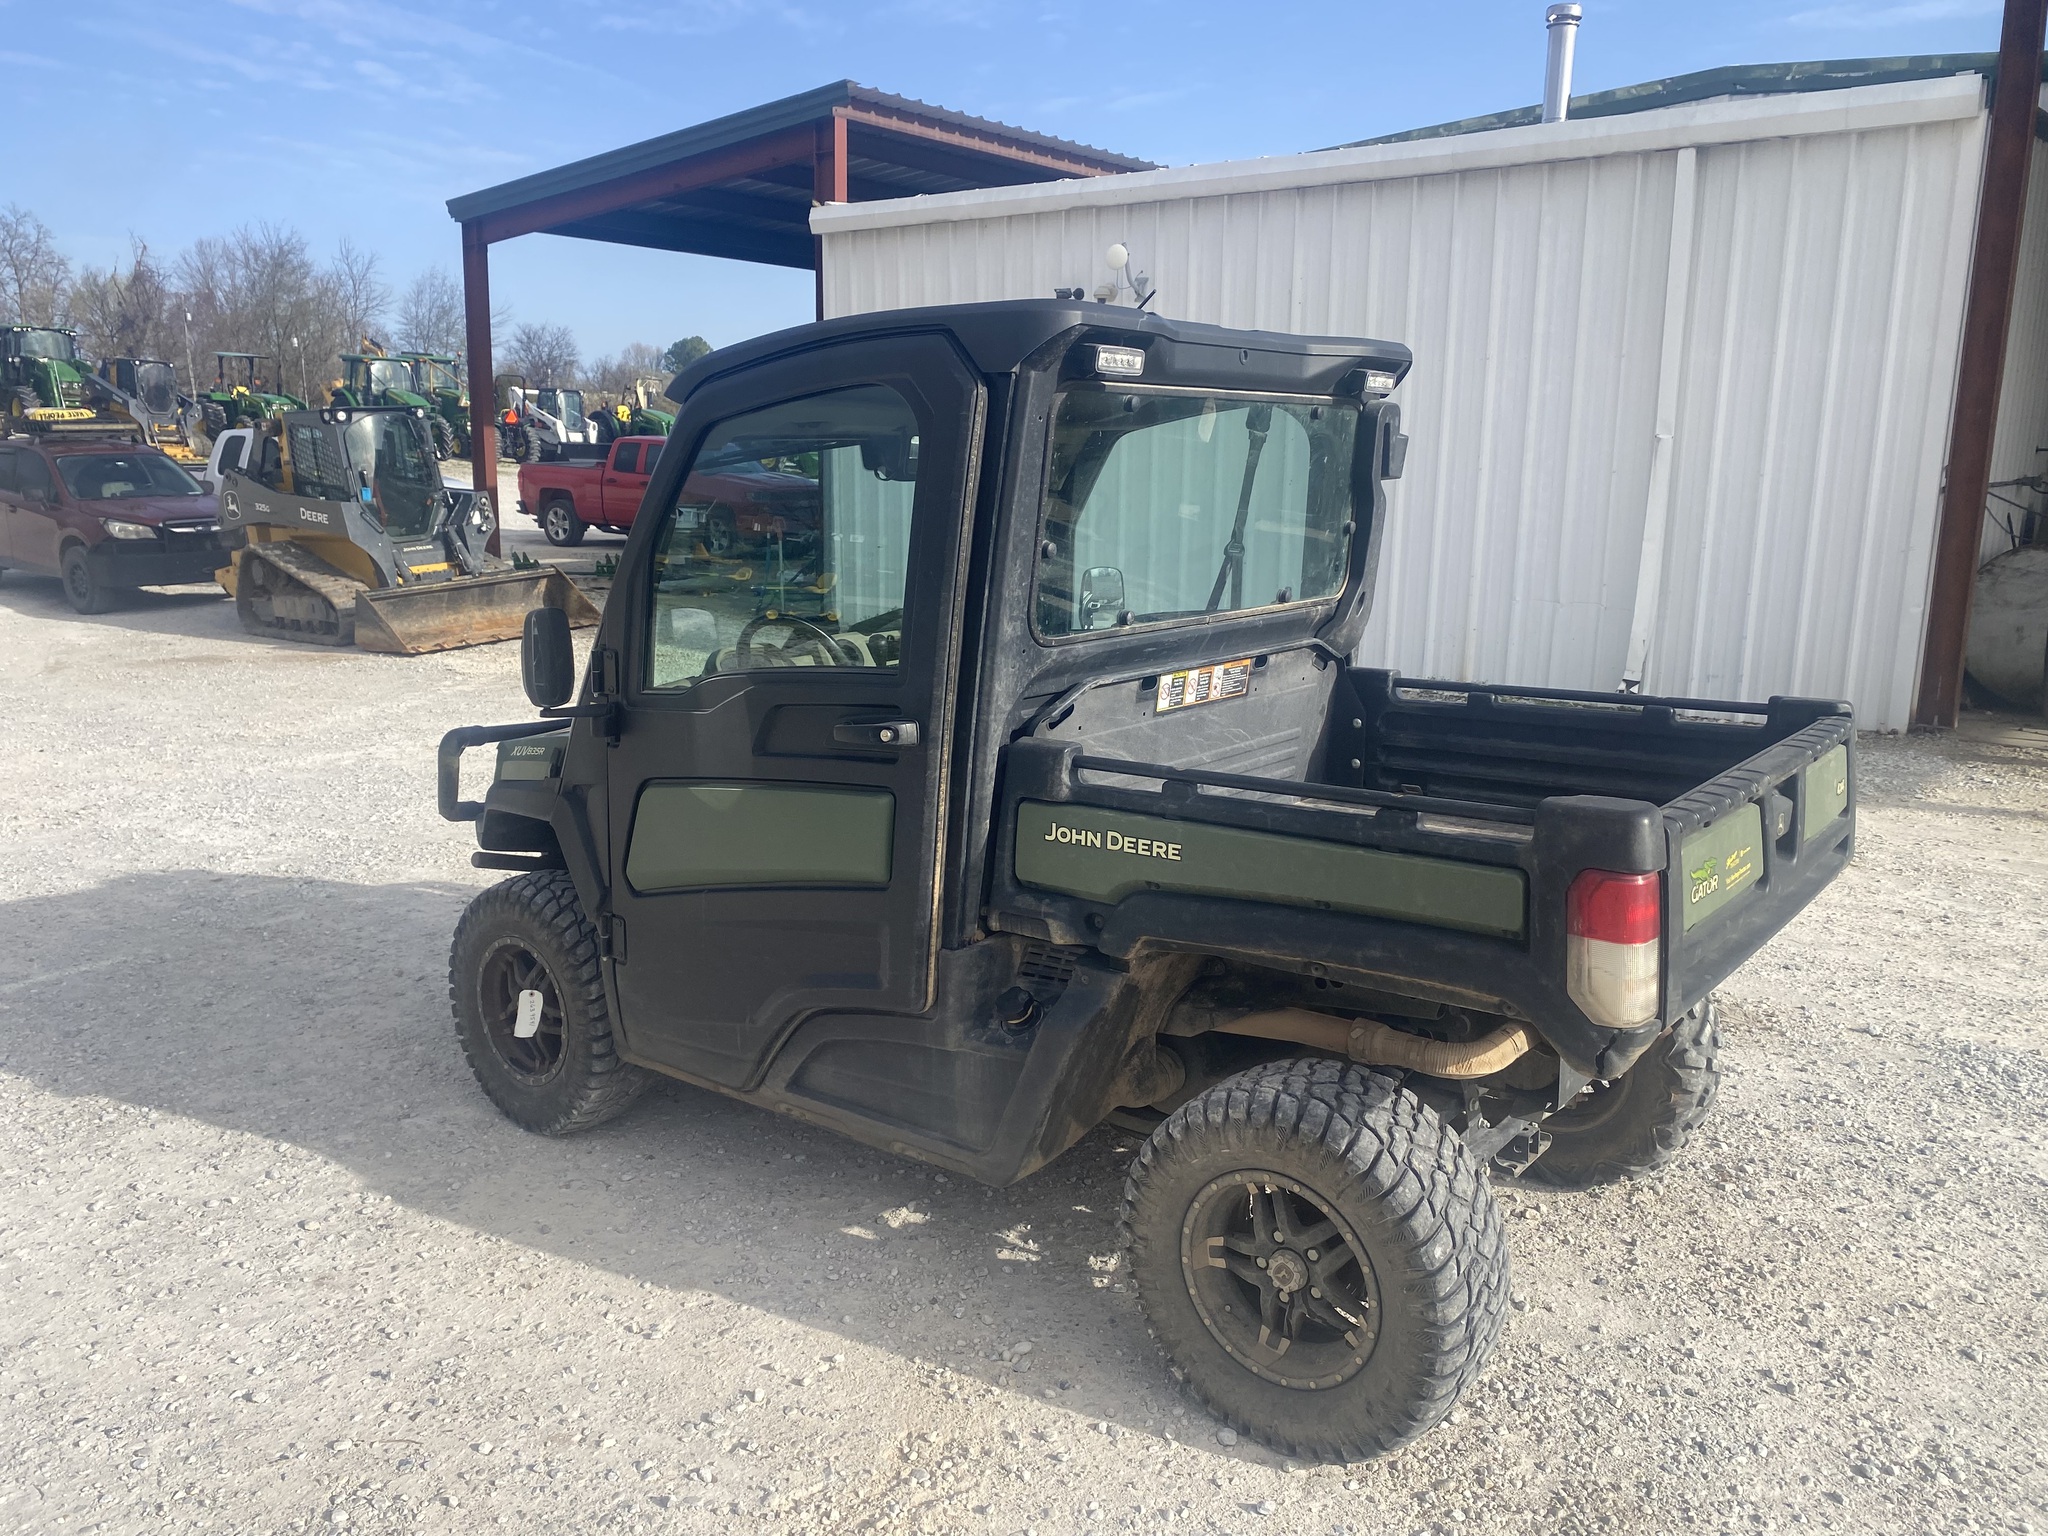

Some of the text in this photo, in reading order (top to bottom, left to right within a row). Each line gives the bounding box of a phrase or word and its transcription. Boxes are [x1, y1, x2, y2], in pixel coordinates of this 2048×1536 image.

[299, 507, 329, 525] DEERE
[1044, 822, 1182, 861] JOHN DEERE
[1691, 873, 1719, 904] GATOR
